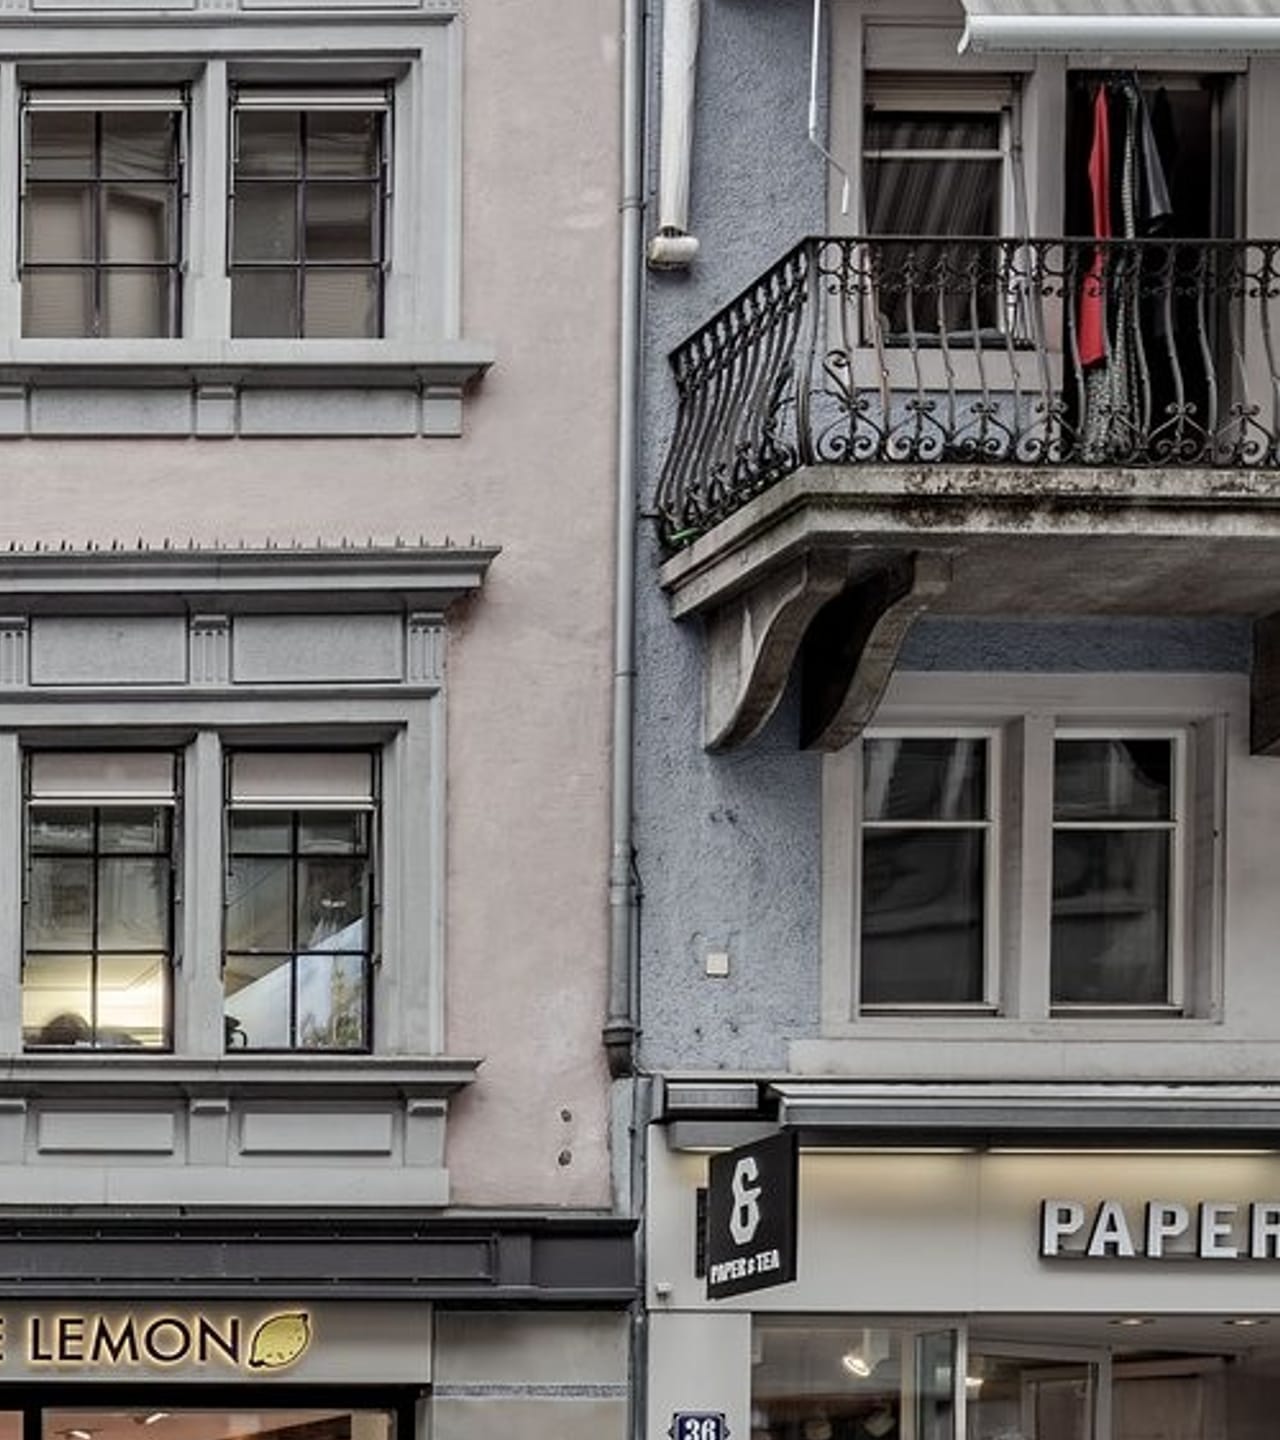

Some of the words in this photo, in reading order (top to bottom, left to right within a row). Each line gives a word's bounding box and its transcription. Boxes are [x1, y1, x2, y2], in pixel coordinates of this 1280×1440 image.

[1041, 1199, 1280, 1259] PAPER
[711, 1257, 746, 1284] PAPER
[755, 1248, 780, 1273] TEA
[29, 1318, 240, 1362] LEMON
